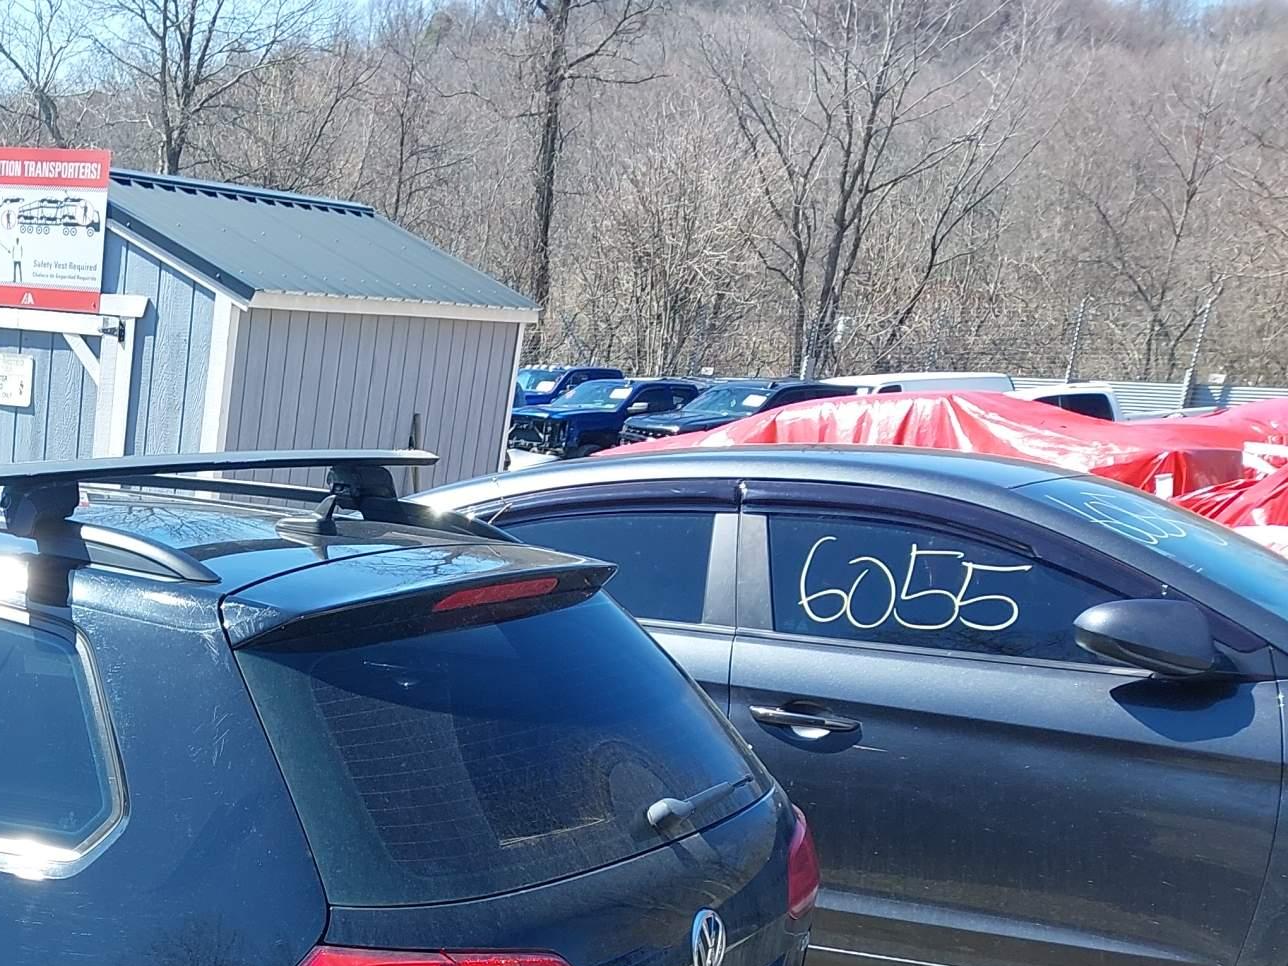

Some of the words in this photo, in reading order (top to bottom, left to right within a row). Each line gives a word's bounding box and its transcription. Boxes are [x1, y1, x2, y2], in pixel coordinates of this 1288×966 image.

[24, 161, 102, 180] TRANSPORTERS!
[33, 260, 53, 270] Safety
[54, 261, 68, 270] Vest
[69, 262, 98, 272] Required
[798, 536, 1032, 631] 6055
